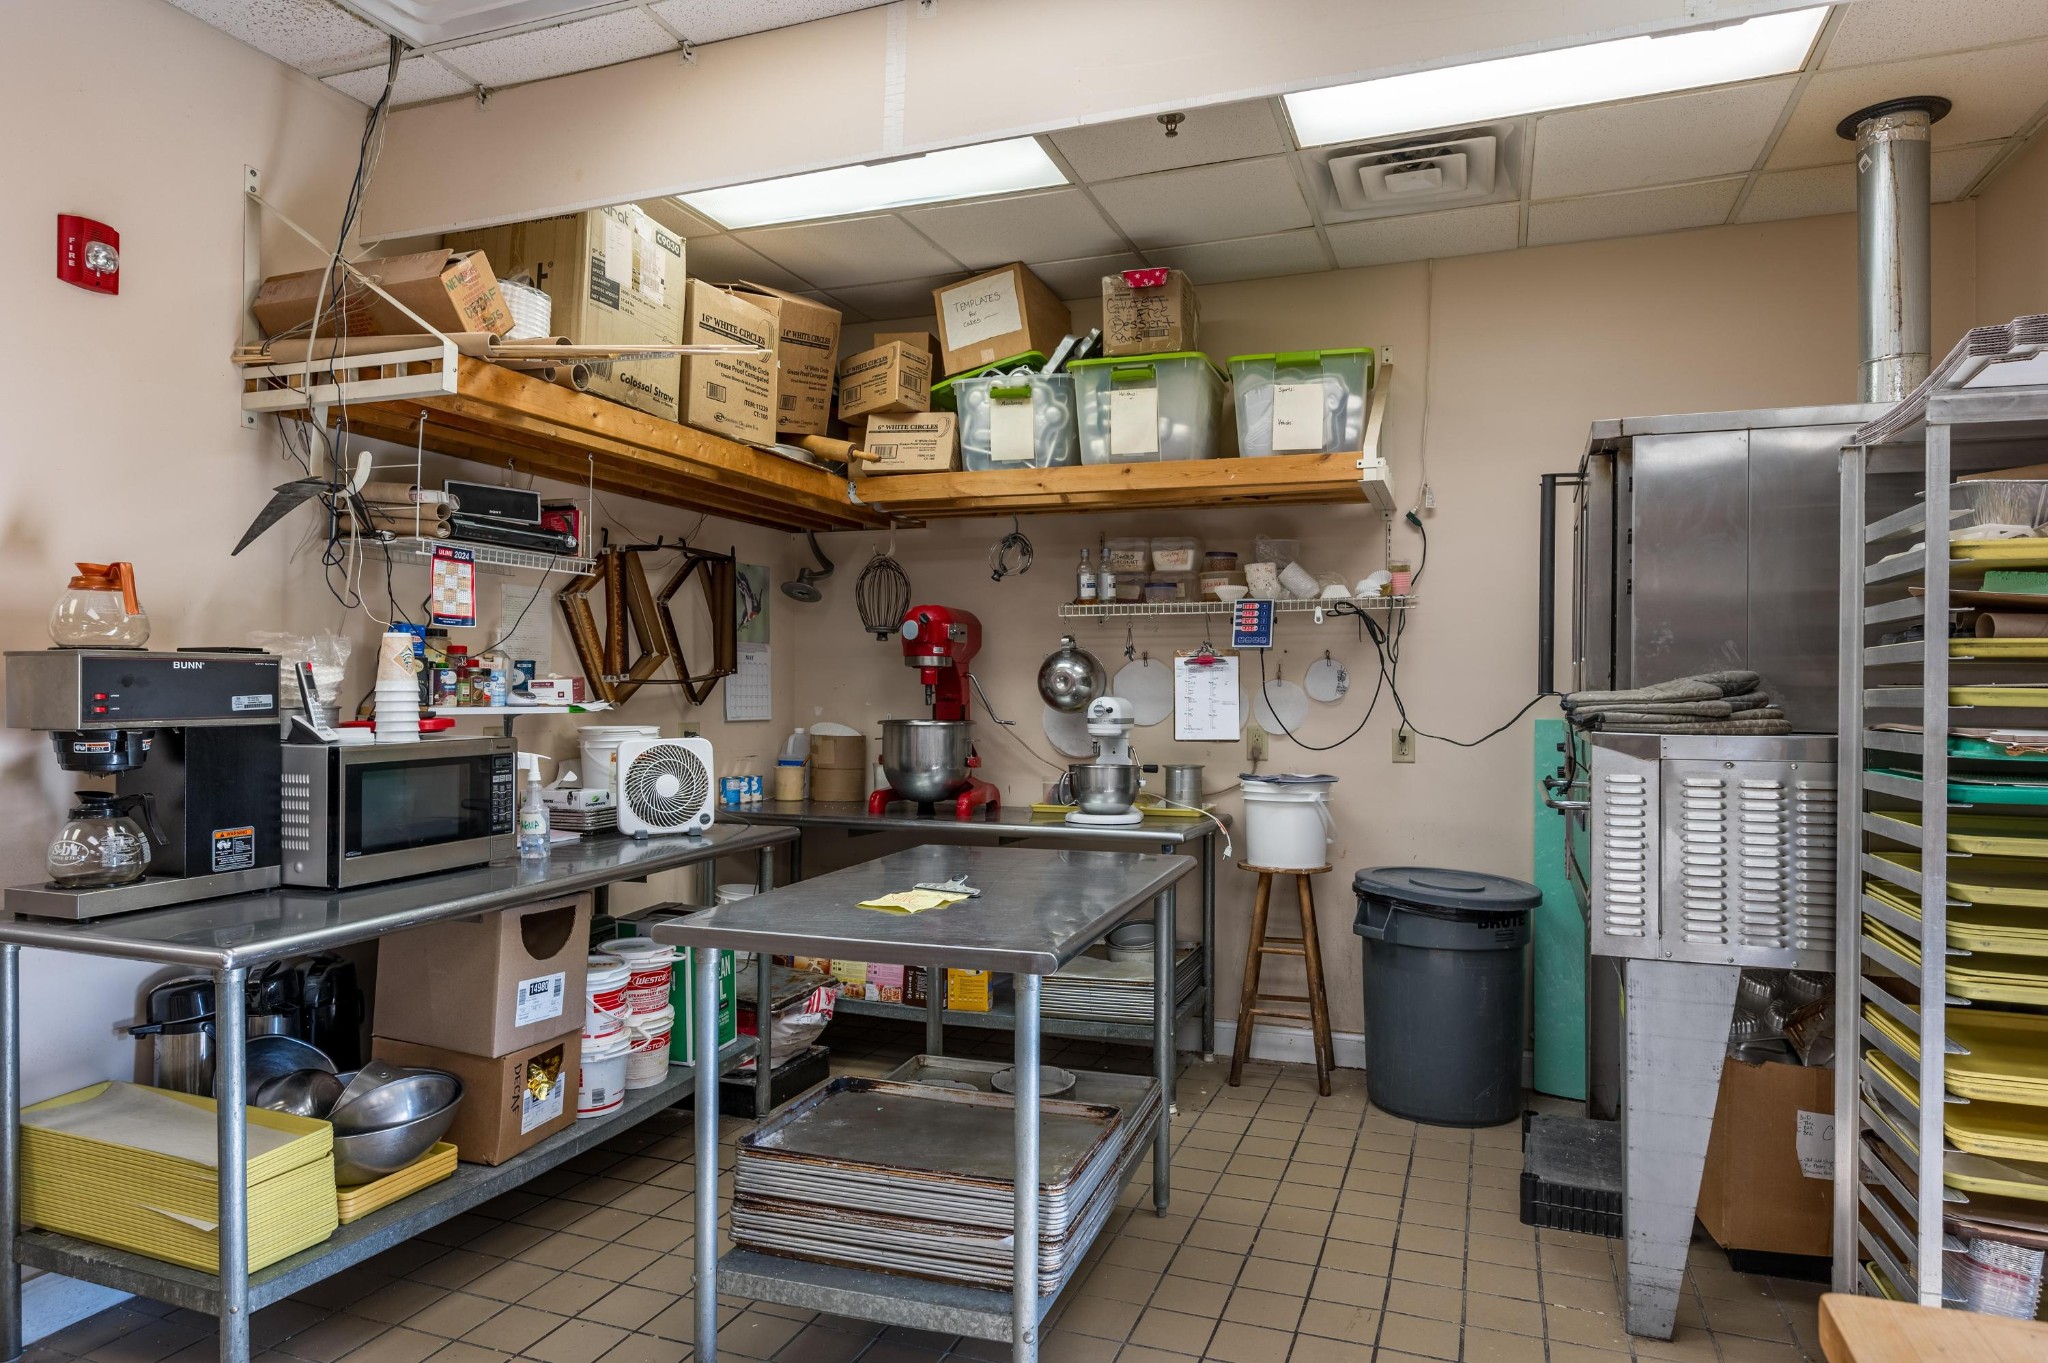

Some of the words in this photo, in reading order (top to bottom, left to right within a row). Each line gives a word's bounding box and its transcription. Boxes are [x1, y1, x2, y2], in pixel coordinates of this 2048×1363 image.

[68, 237, 76, 267] FIRE
[656, 233, 681, 255] C9030
[953, 292, 1002, 315] TEMPLATES
[1107, 295, 1165, 314] Gluten
[1137, 307, 1171, 319] Free
[701, 313, 712, 323] 16"
[713, 317, 739, 335] WHITE
[739, 328, 766, 346] CIRCLES
[963, 318, 982, 328] cakes
[1108, 318, 1176, 334] Dessert
[783, 329, 791, 337] 14"
[792, 330, 811, 341] WHITE
[811, 335, 831, 345] CIRCLES
[715, 359, 732, 371] Grease
[732, 366, 745, 376] Proof
[745, 370, 770, 384] Corrugated
[620, 372, 652, 394] Colossal
[653, 387, 675, 403] Straw
[438, 549, 453, 558] ULINE
[454, 551, 471, 560] 2024
[636, 974, 667, 985] WESTCO
[512, 1063, 522, 1116] DECAF
